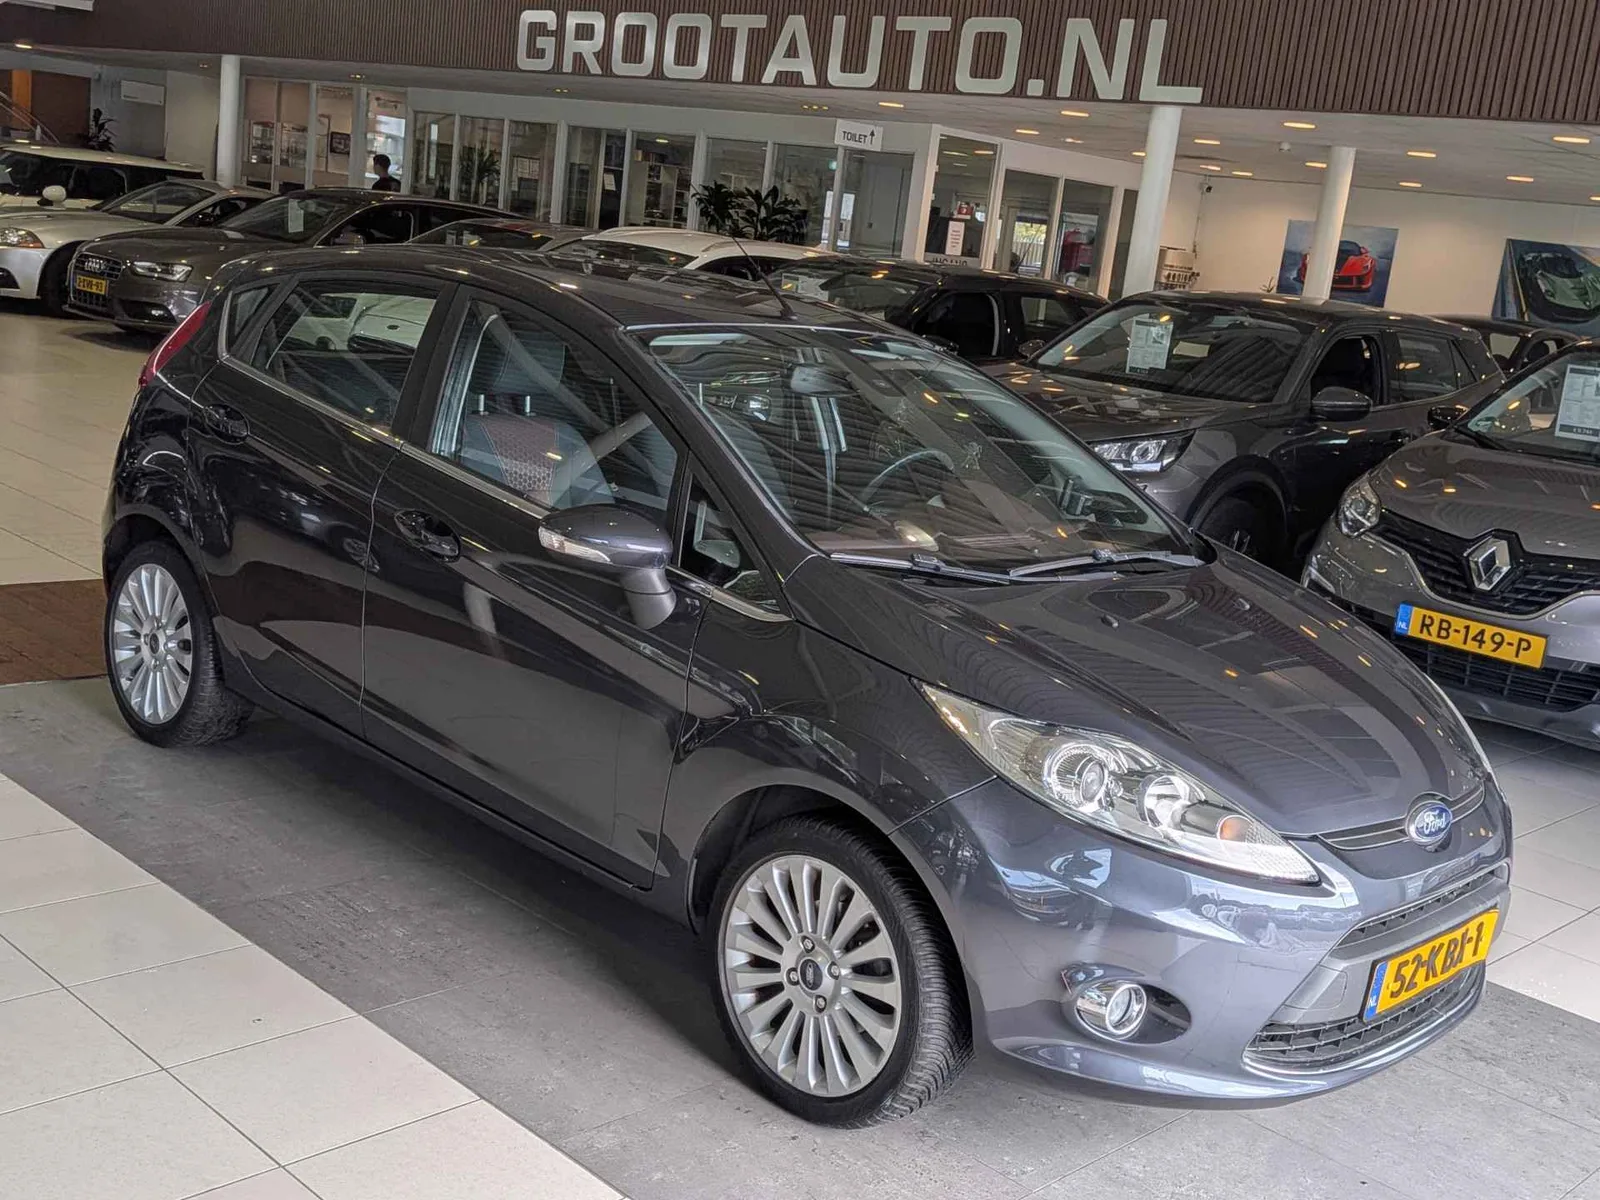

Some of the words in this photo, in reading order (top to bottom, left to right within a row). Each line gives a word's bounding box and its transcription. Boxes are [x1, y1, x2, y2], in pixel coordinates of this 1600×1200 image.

[517, 10, 1203, 104] GROOTAUTO.NL
[842, 130, 868, 144] TOILET
[1419, 613, 1532, 659] RB-149-P
[1416, 810, 1446, 834] Ford
